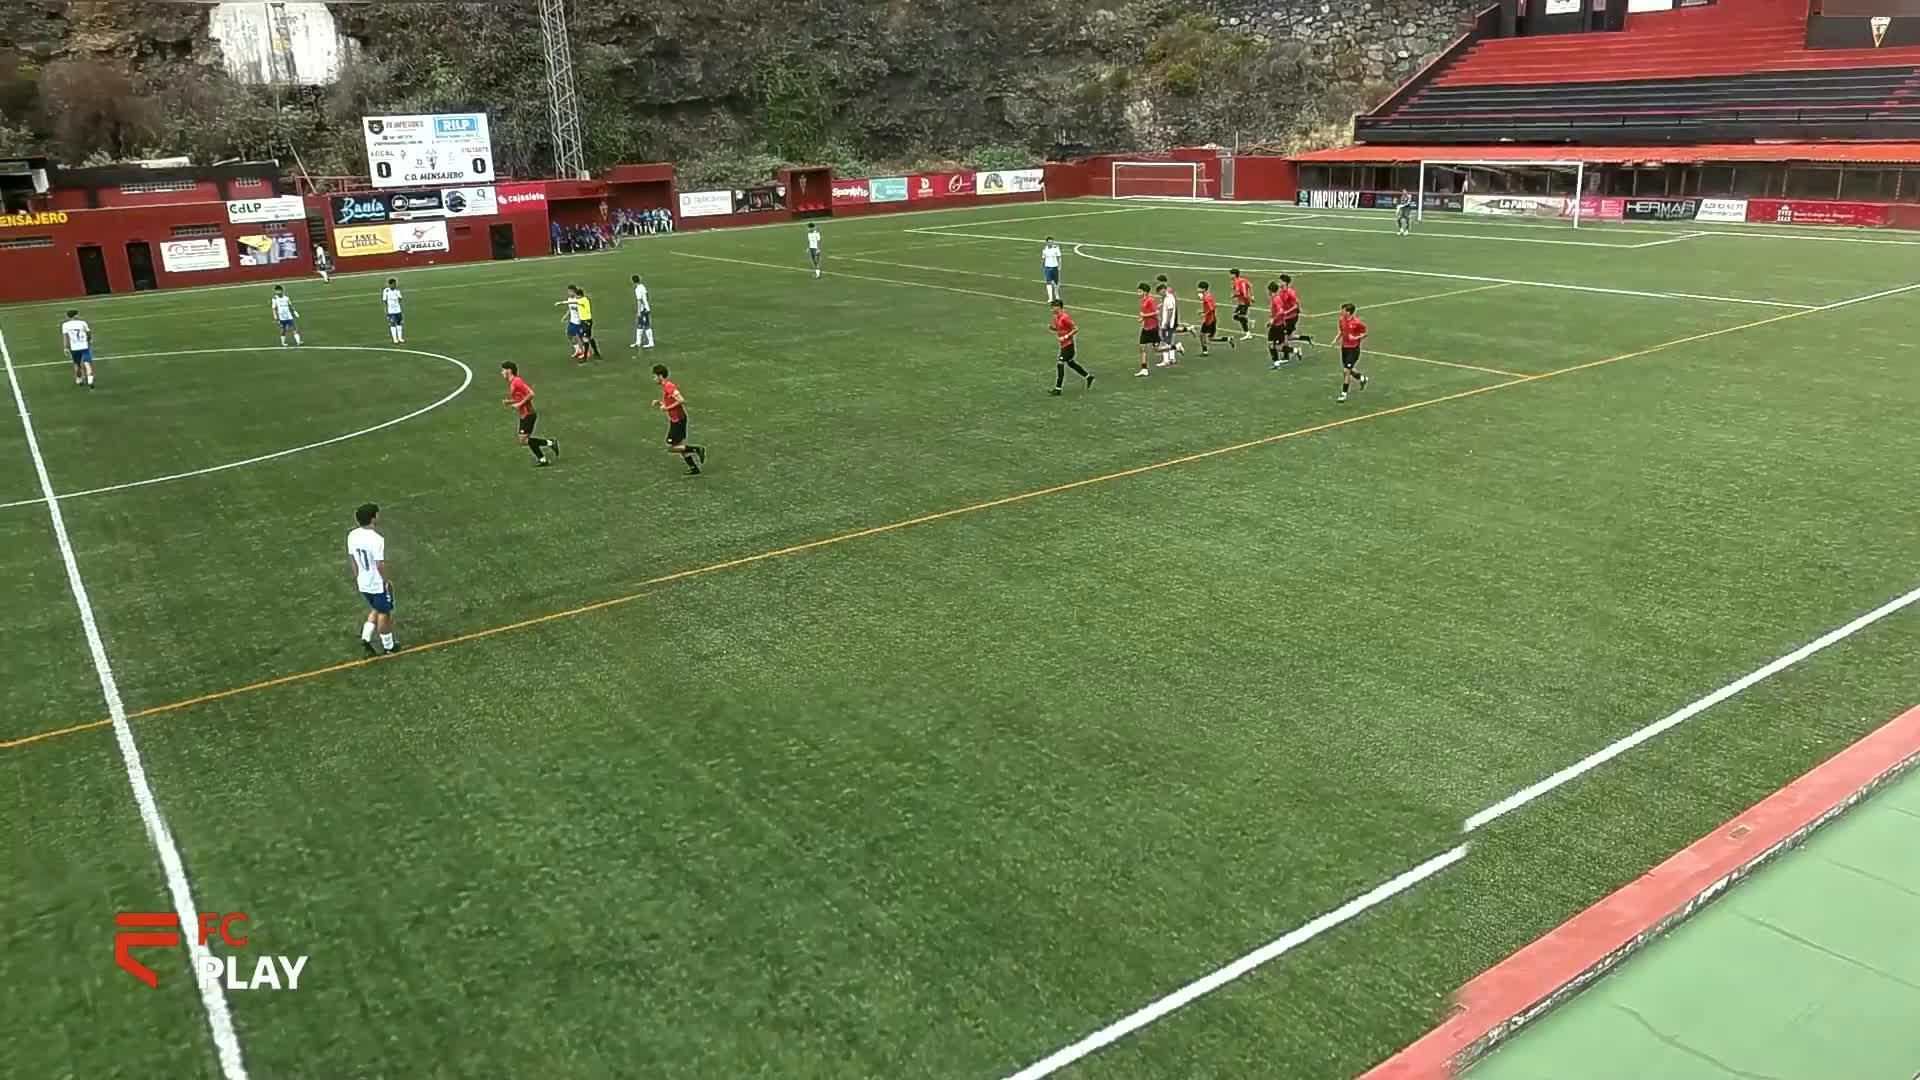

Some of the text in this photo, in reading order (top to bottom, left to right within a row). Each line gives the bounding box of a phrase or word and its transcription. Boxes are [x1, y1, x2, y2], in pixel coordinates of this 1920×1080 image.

[376, 161, 392, 178] 0
[472, 157, 487, 174] 0
[419, 171, 464, 181] MENSAJERO
[1310, 190, 1360, 209] IMPULSO27
[229, 203, 262, 214] CdLP
[356, 549, 369, 571] 11
